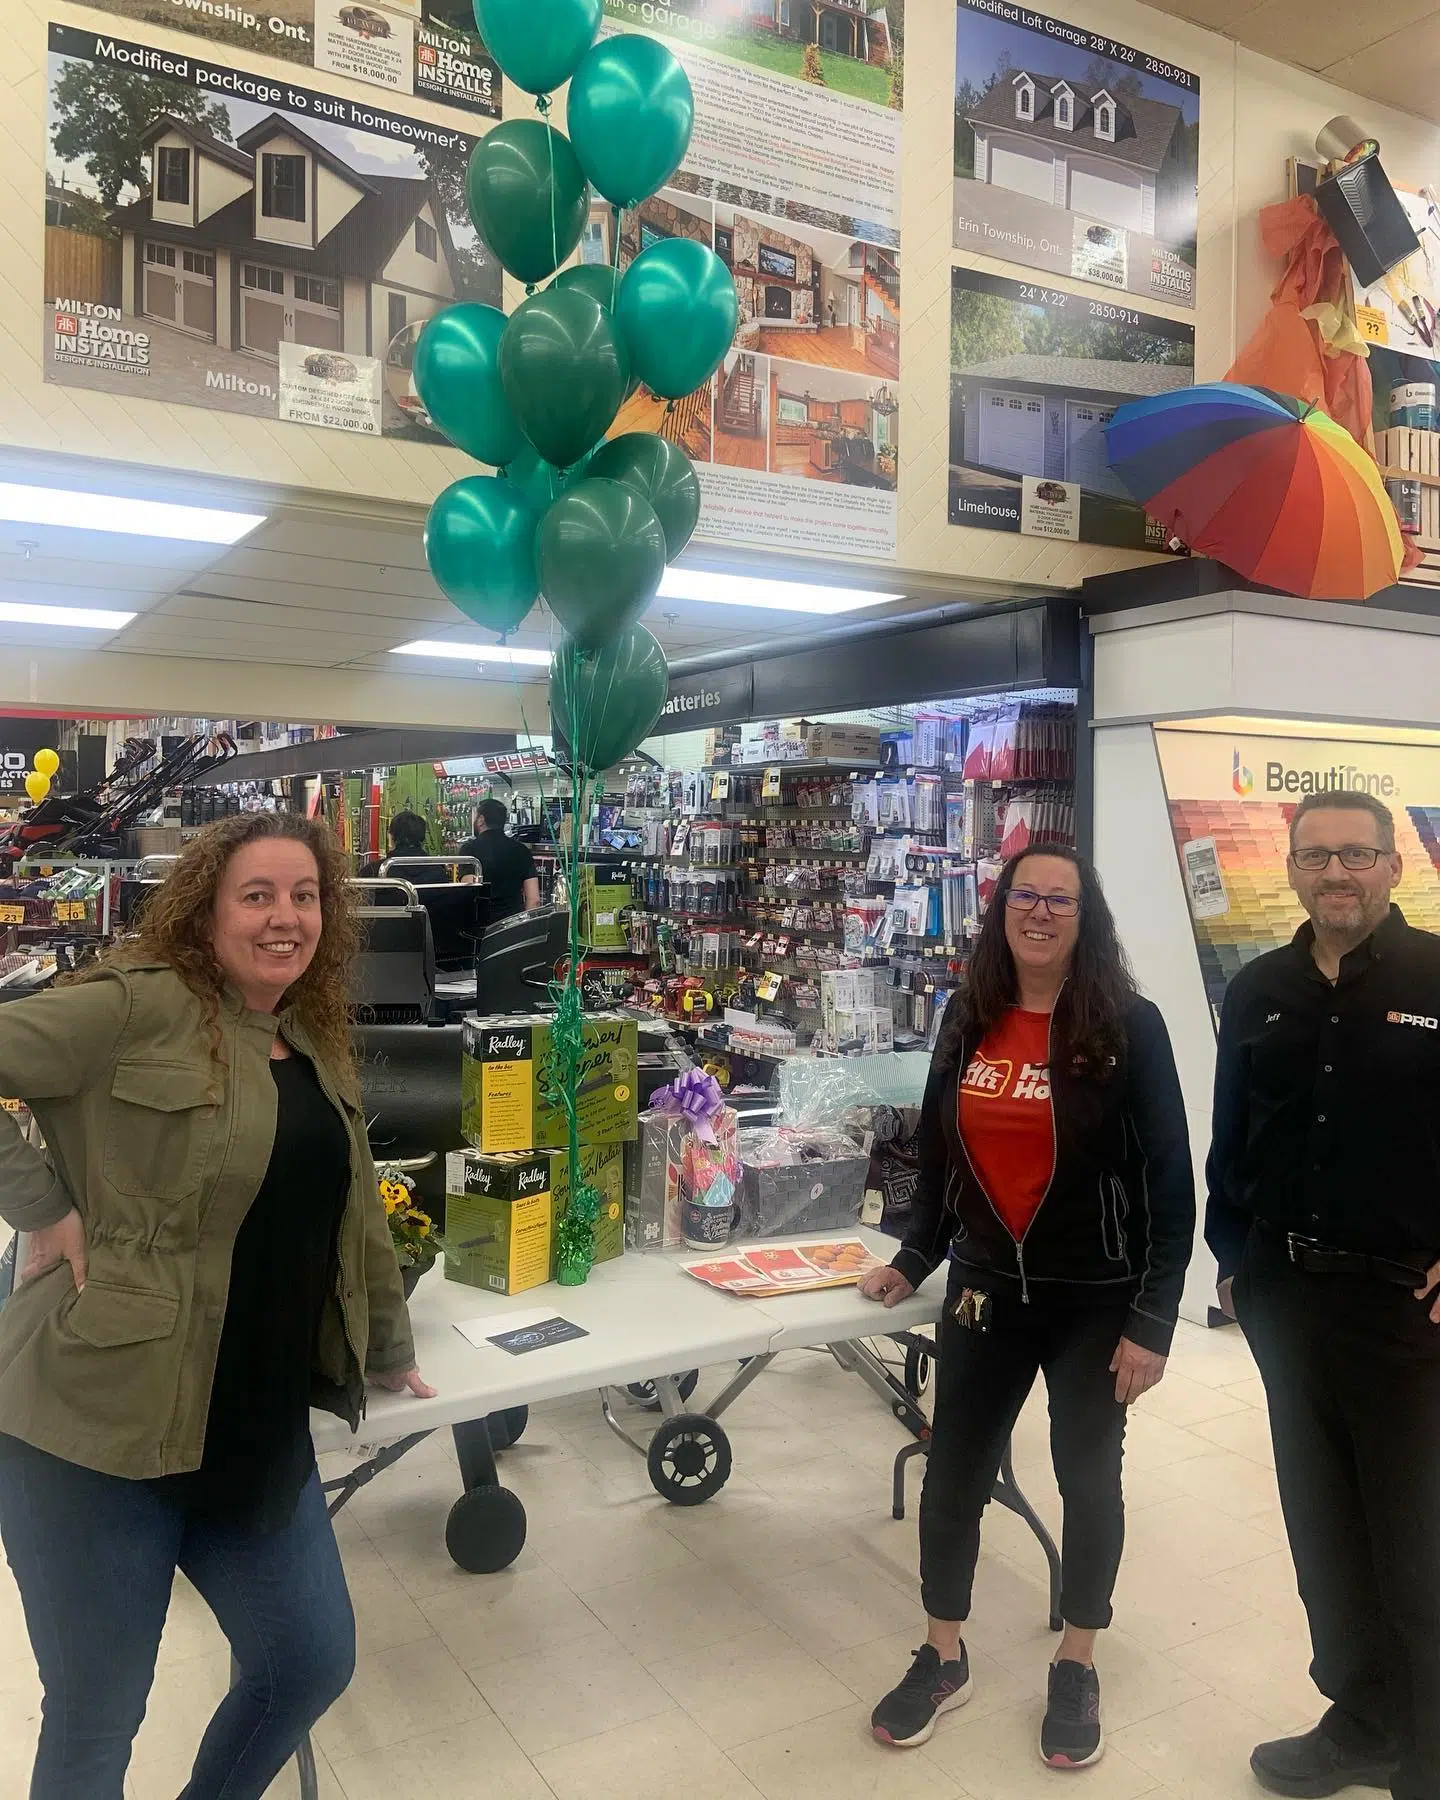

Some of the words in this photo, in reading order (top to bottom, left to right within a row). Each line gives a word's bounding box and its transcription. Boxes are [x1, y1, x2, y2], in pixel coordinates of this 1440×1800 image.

[267, 17, 311, 43] Ont.
[628, 4, 637, 13] a
[641, 2, 718, 40] garage
[327, 38, 356, 49] MATERIAL
[345, 36, 378, 50] HARDWARE
[378, 46, 401, 57] GARAGE
[418, 30, 471, 57] MILTON
[967, 0, 1018, 21] Modified
[1021, 10, 1043, 30] Loft
[1045, 15, 1087, 46] Garage
[1090, 35, 1107, 51] 28'
[1110, 43, 1118, 57] X
[1120, 46, 1136, 63] 26'
[1145, 56, 1192, 87] 2850-931
[331, 60, 351, 70] FROM
[437, 50, 493, 81] Home
[418, 63, 492, 96] INSTALLS
[95, 38, 188, 77] Modified
[195, 67, 282, 102] package
[288, 90, 307, 108] to
[313, 100, 345, 119] suit
[351, 105, 467, 152] homeowner's
[418, 81, 443, 93] DESIGN
[450, 89, 492, 106] INSTALLATION
[959, 216, 979, 234] Erin
[982, 222, 1036, 250] Township,
[1040, 238, 1063, 256] Ont.
[1151, 247, 1180, 263] MILTON
[1150, 272, 1191, 293] INSTALLS
[1161, 261, 1191, 282] Home
[55, 297, 121, 322] MILTON
[1019, 285, 1037, 299] 24'
[1040, 290, 1048, 303] X
[1051, 293, 1068, 307] 22'
[1089, 302, 1140, 325] 2850-914
[78, 317, 150, 348] Home
[55, 333, 150, 365] INSTALLS
[54, 353, 85, 365] DESIGN
[86, 359, 94, 367] &
[94, 360, 151, 376] INSTALLATION
[205, 370, 277, 401] Milton,
[289, 409, 320, 422] FROM
[958, 497, 1020, 521] Limehouse,
[1265, 1012, 1281, 1024] Jeff
[1399, 1013, 1439, 1030] PRO
[488, 1034, 526, 1056] Radley
[464, 1165, 493, 1193] Radley
[518, 1168, 547, 1191] Radley
